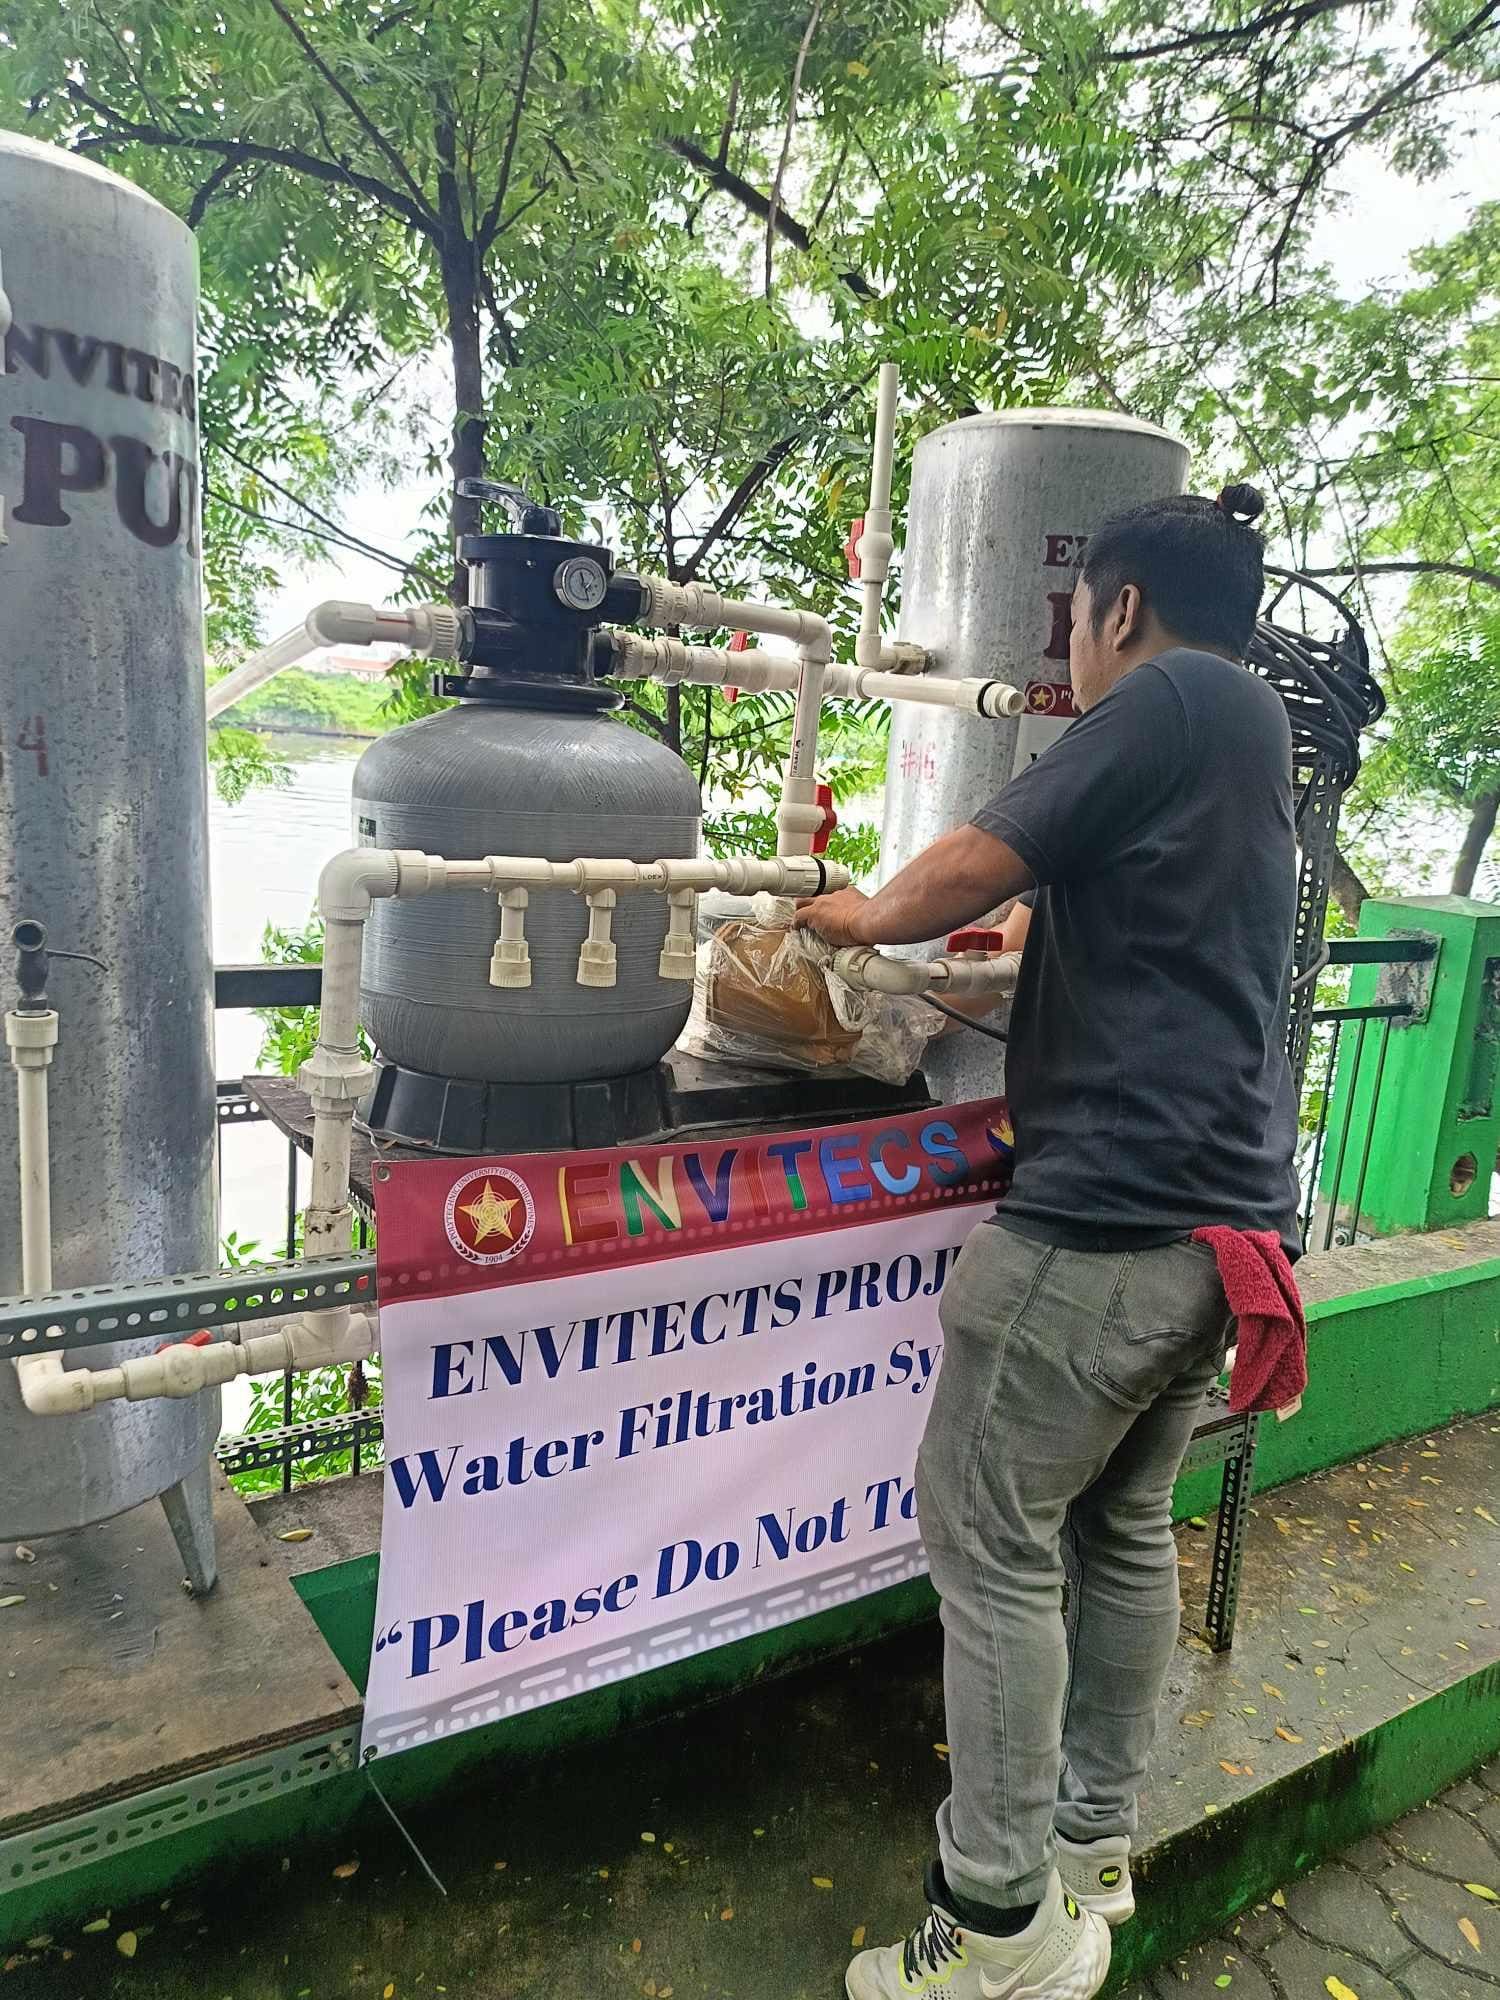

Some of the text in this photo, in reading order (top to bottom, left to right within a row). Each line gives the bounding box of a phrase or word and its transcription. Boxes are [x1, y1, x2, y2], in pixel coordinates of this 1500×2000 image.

[10, 414, 199, 559] PU
[446, 1167, 534, 1240] POLYTECHNIC UNIVERSITY OF THE PHILIPPINES
[558, 1120, 970, 1246] ENVITECS
[484, 1255, 503, 1264] 1904
[426, 1278, 802, 1400] ENVITECTS
[388, 1429, 605, 1509] Water
[614, 1361, 876, 1461] Filtration
[650, 1537, 740, 1602] Do
[751, 1496, 854, 1571] Not
